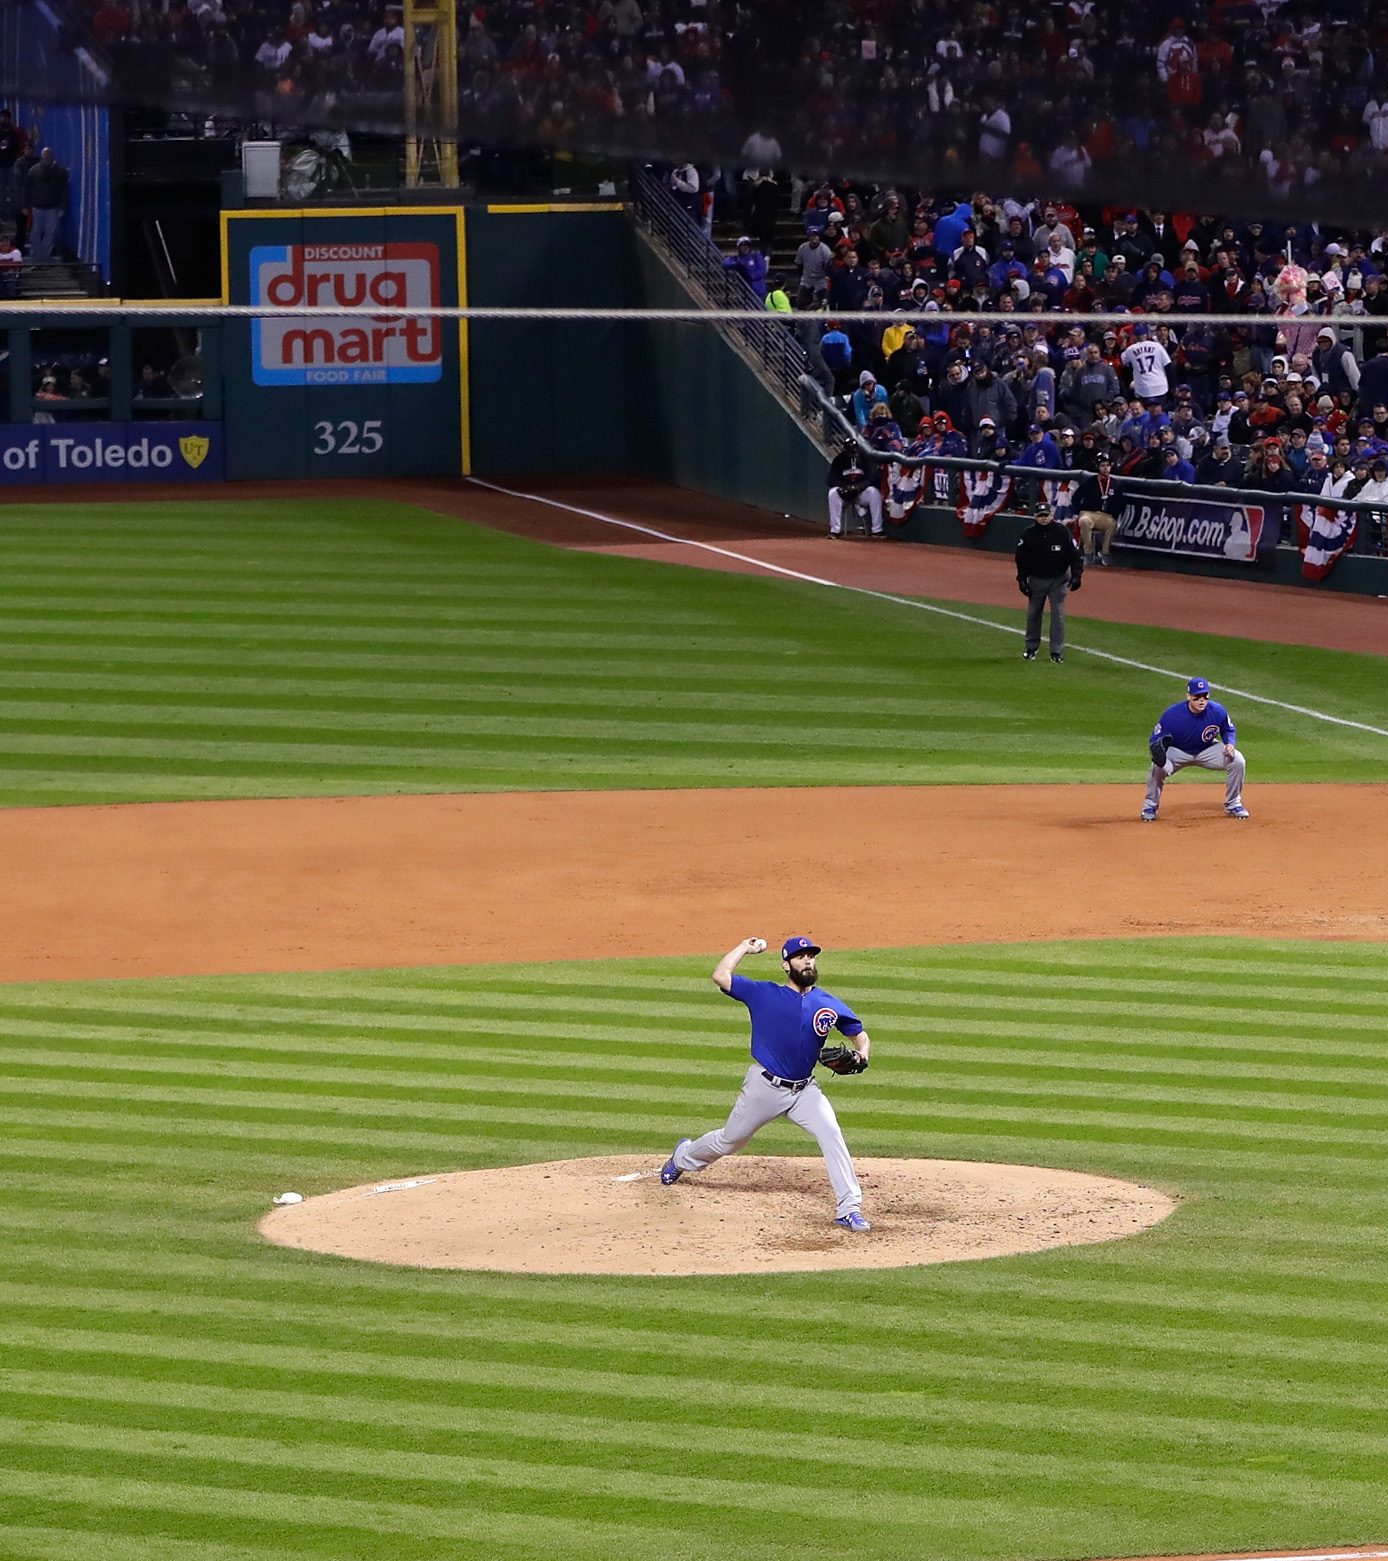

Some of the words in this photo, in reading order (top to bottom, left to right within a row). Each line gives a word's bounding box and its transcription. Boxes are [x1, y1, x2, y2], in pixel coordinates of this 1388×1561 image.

[304, 246, 385, 260] DISCOUNT
[267, 246, 407, 323] drug
[281, 317, 442, 364] mart
[306, 369, 350, 382] FOOD
[353, 369, 388, 381] FAIR
[1136, 355, 1155, 374] 17
[313, 420, 384, 455] 325
[2, 439, 39, 471] of
[50, 438, 173, 469] Toledo
